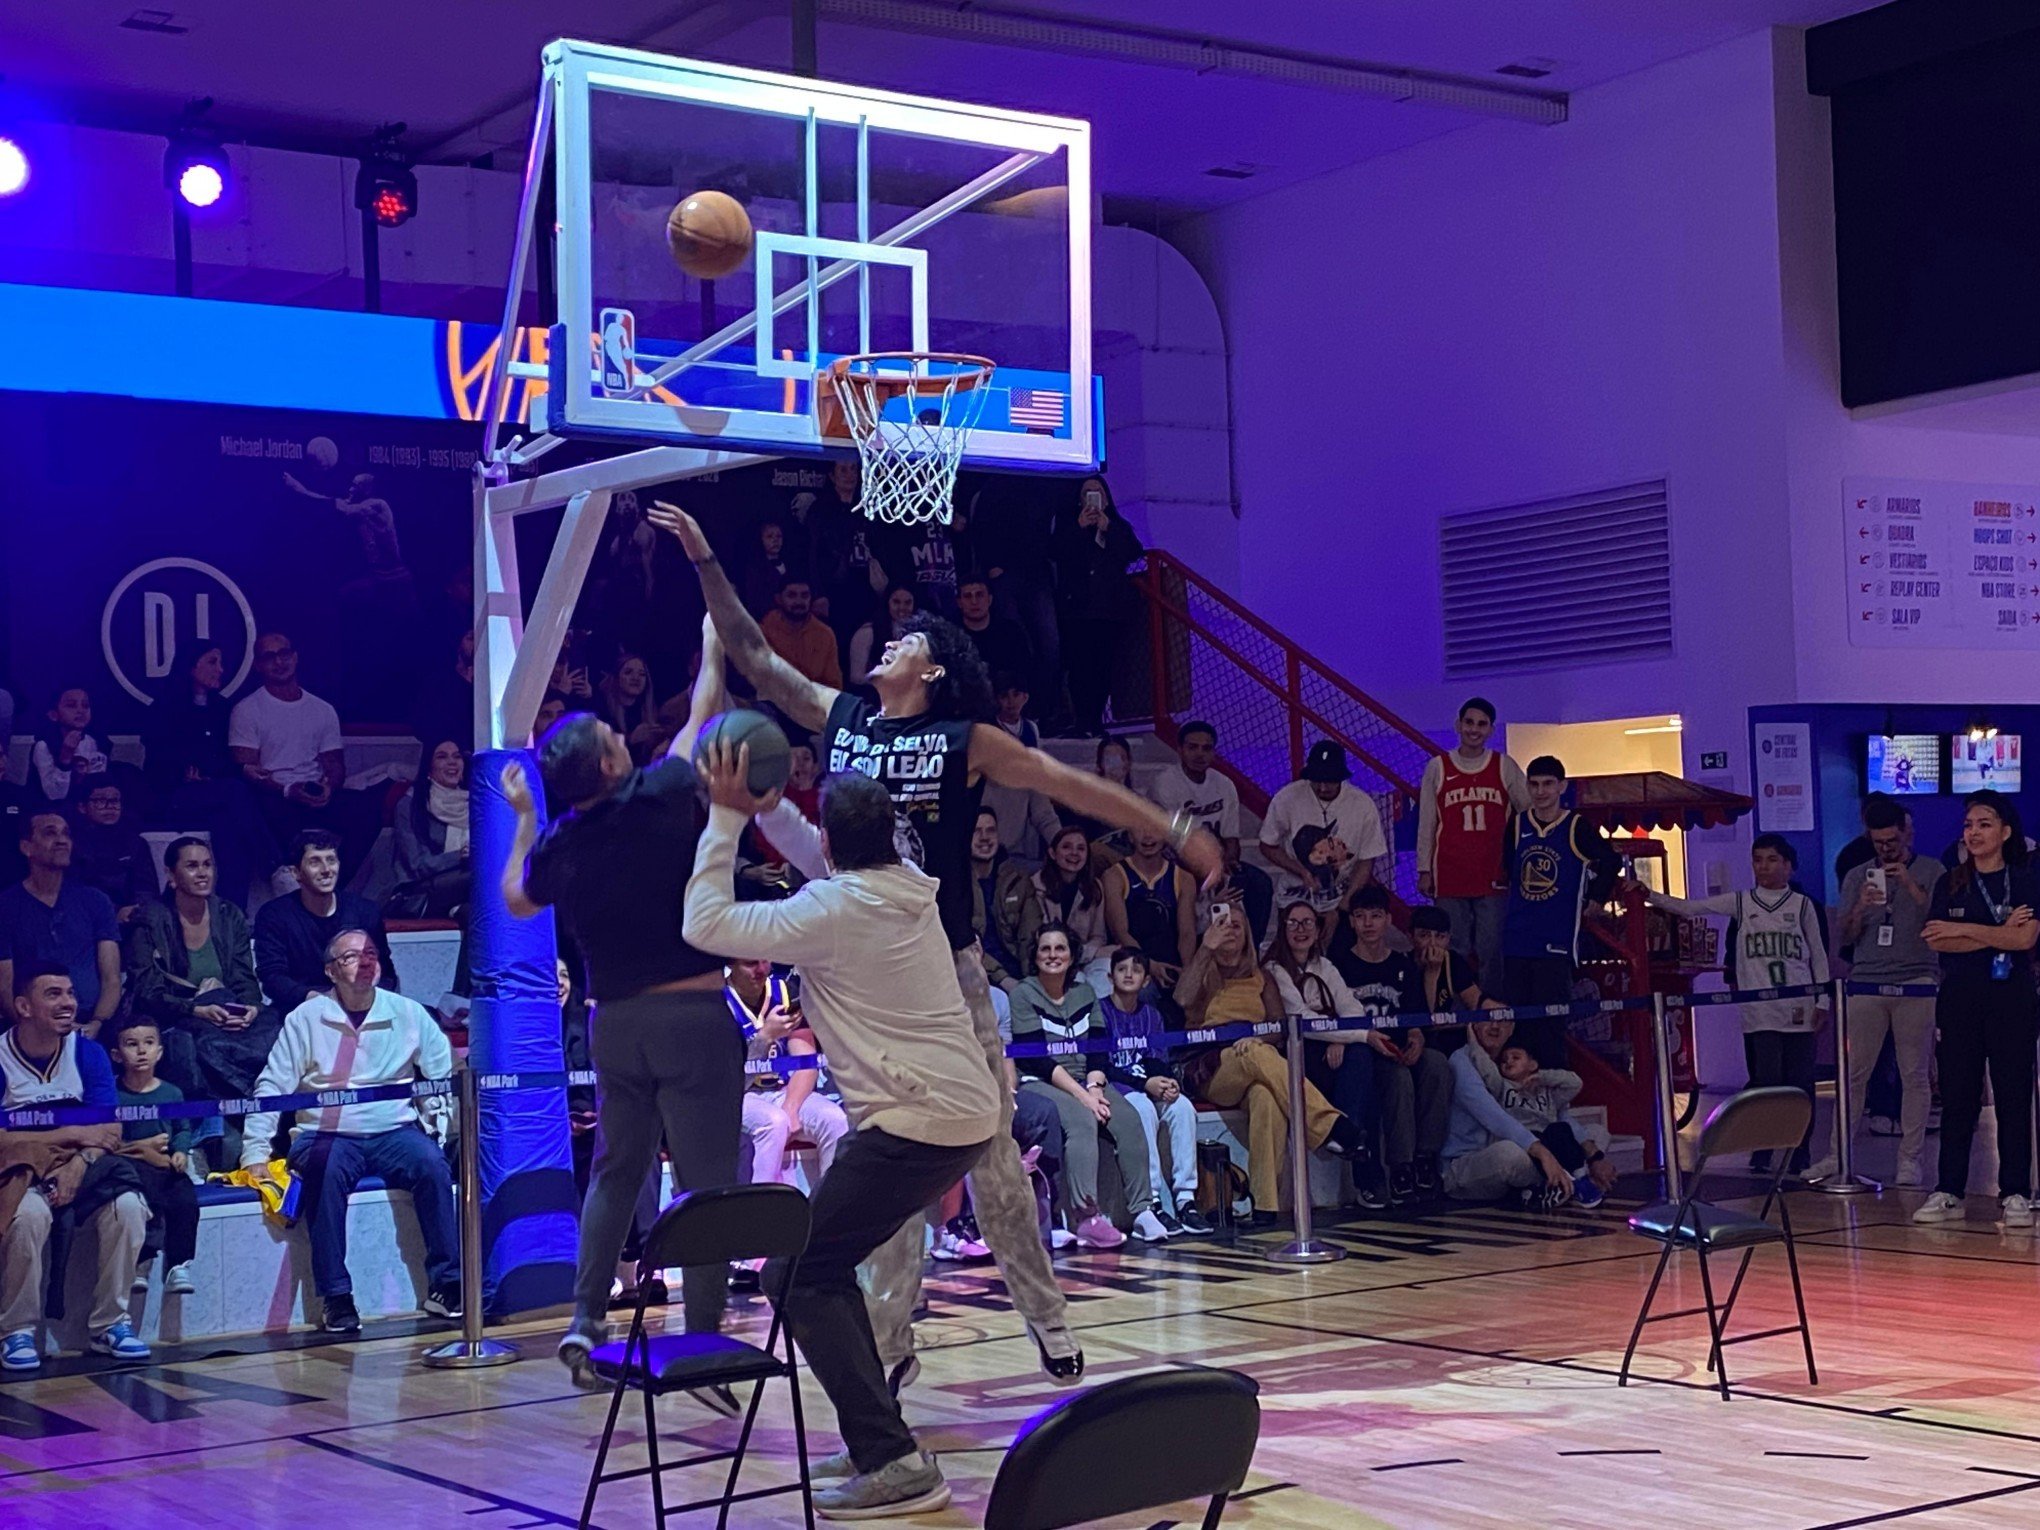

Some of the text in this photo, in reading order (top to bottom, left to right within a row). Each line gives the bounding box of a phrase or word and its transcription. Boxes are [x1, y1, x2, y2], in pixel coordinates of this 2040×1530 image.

[606, 372, 623, 388] NBA
[220, 435, 303, 459] Michael Jordan
[771, 467, 798, 487] Jason
[1890, 580, 1940, 597] REPLAY CENTER
[1981, 582, 1994, 598] NBA
[1892, 608, 1920, 624] SALA VIP
[833, 727, 854, 747] EU
[892, 728, 948, 753] SELVA
[829, 748, 850, 773] EU
[886, 751, 944, 779] LEÃO
[1444, 786, 1503, 808] ATLANTA
[1462, 804, 1486, 831] 11
[1536, 858, 1551, 871] 30
[1745, 931, 1803, 961] CELTICS
[1768, 960, 1787, 987] 0
[1191, 1029, 1216, 1042] NBA Park
[1256, 1020, 1281, 1035] NBA Park
[1052, 1041, 1078, 1054] NBA Park
[1121, 1035, 1147, 1049] NBA Park
[756, 1058, 773, 1073] Park
[417, 1080, 452, 1096] NBA Park
[486, 1073, 519, 1089] NBA Park
[322, 1088, 358, 1106] NBA Park
[1504, 1088, 1548, 1112] GAP
[121, 1104, 159, 1120] NBA Park
[224, 1098, 261, 1115] NBA Park
[15, 1109, 54, 1126] NBA Park
